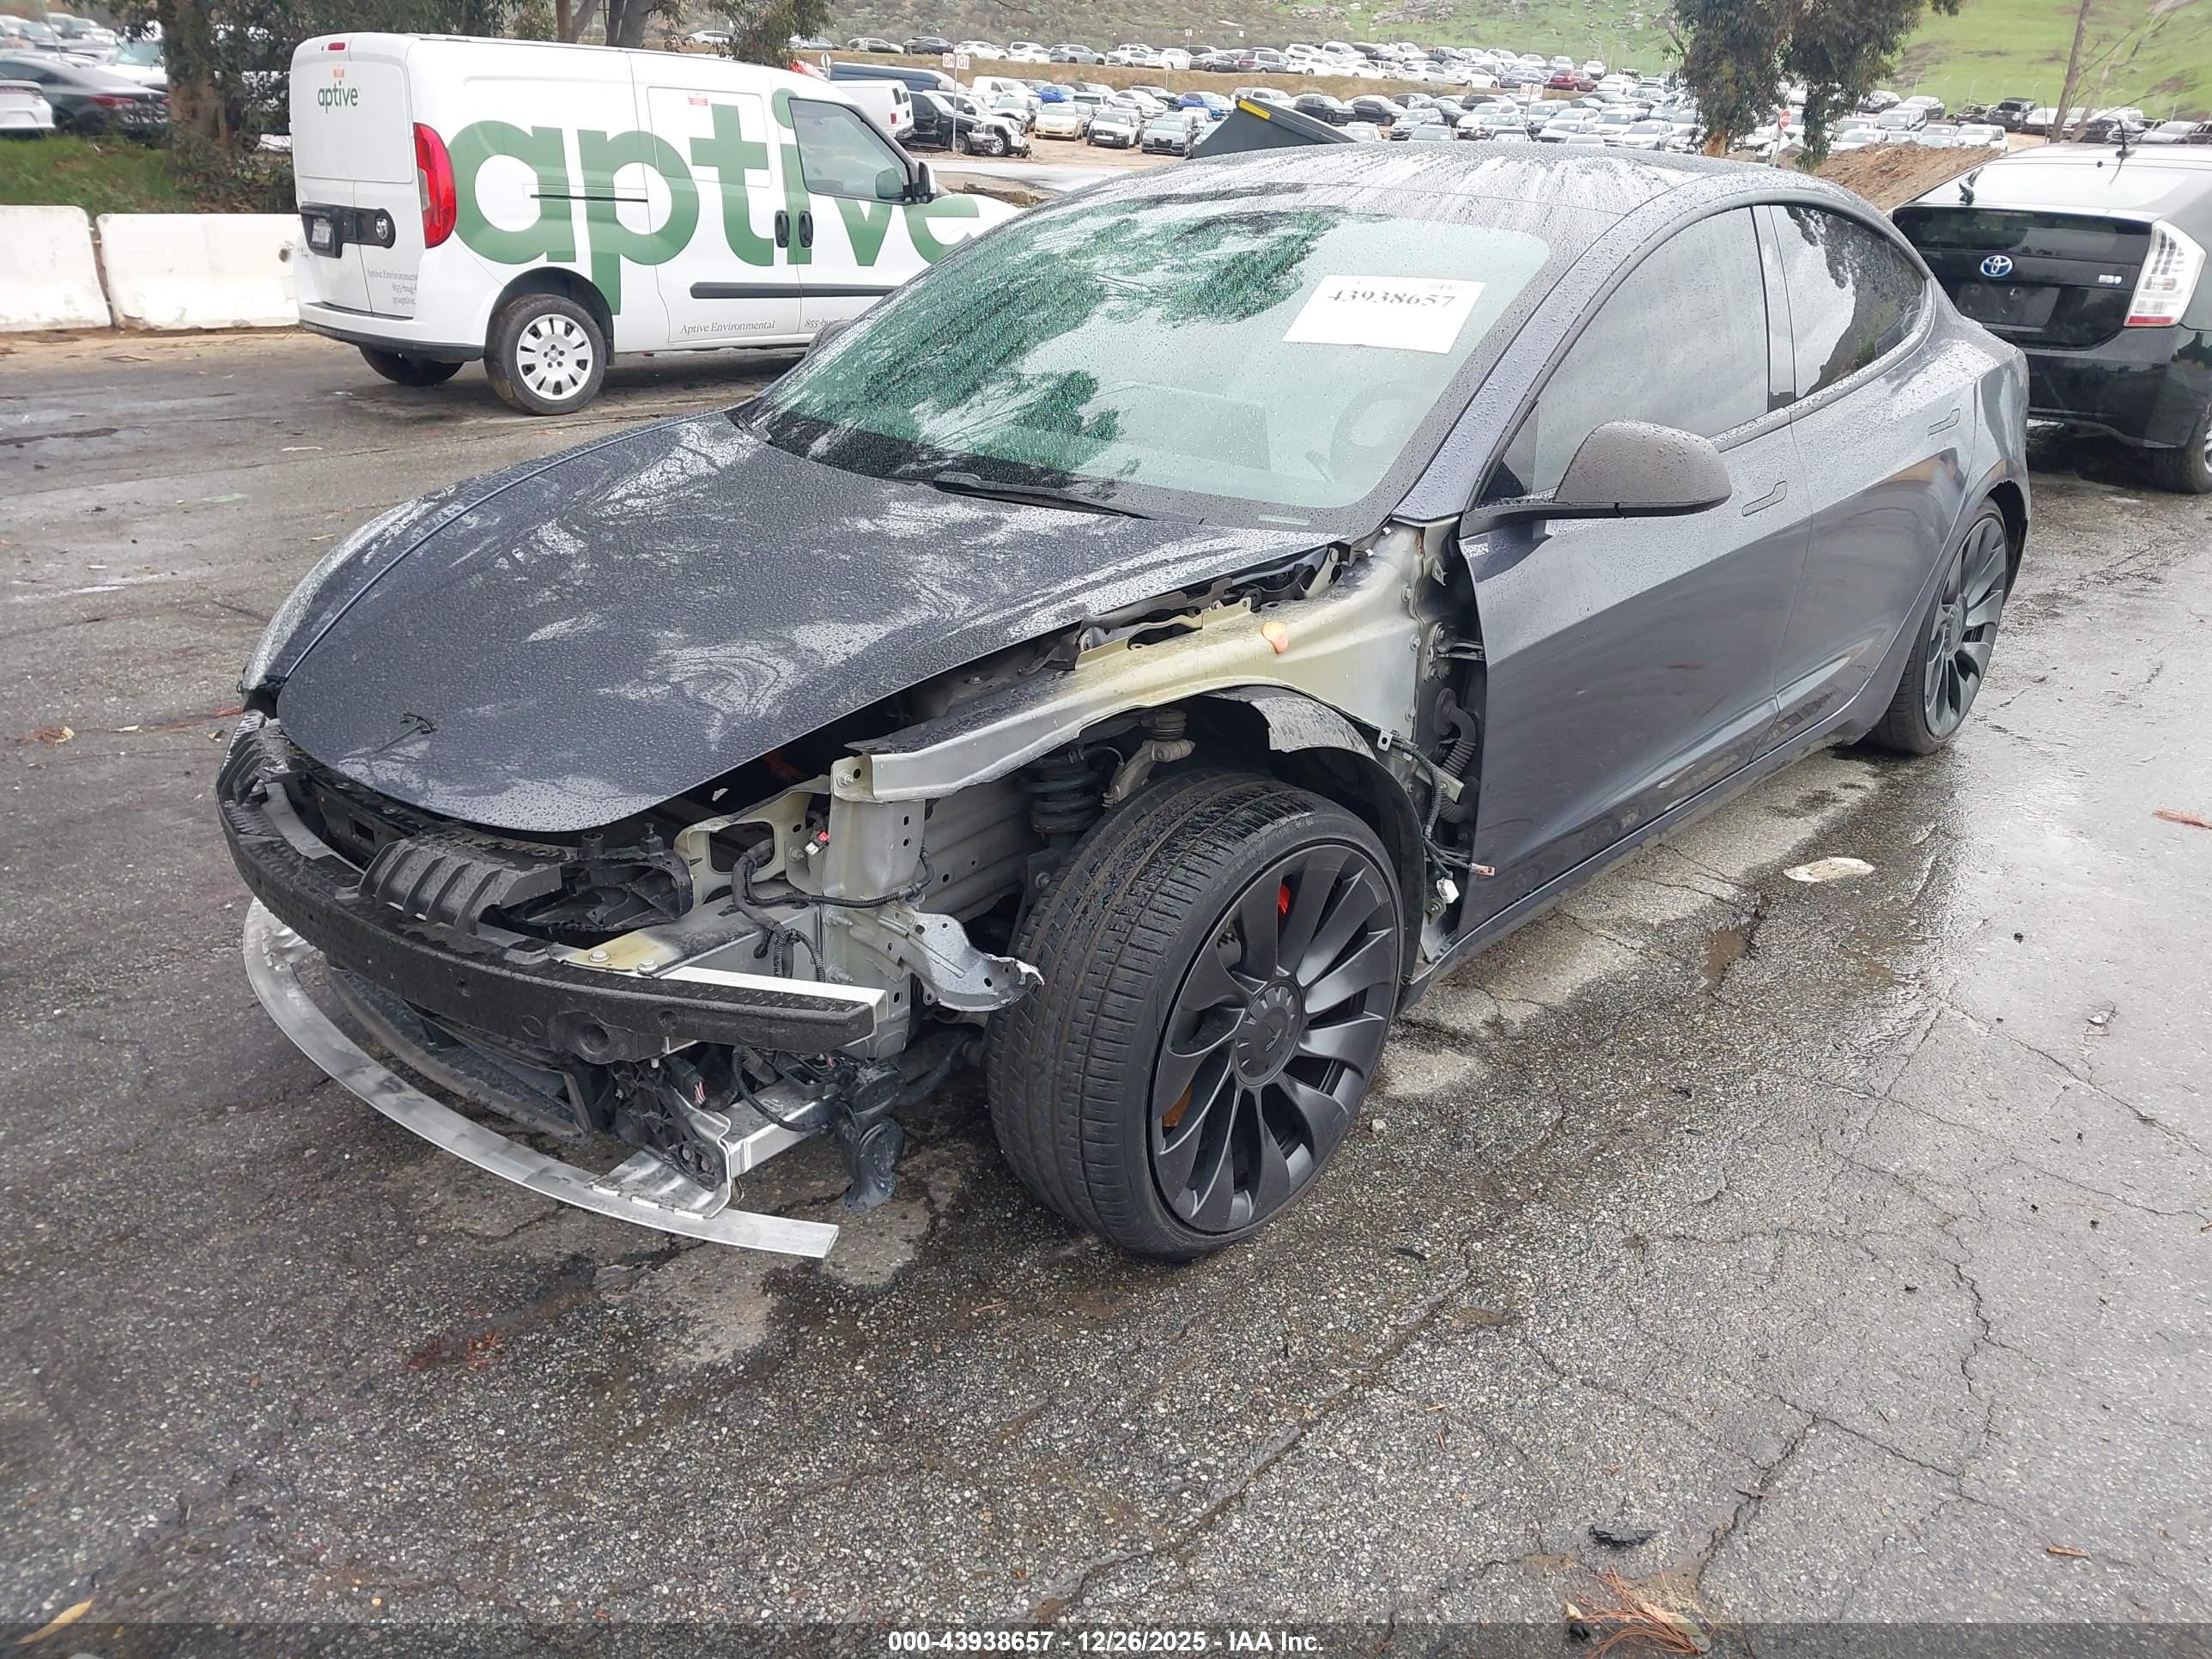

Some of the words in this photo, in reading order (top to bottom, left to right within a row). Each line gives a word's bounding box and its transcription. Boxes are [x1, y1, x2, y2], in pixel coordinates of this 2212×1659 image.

[944, 55, 954, 65] GH
[318, 80, 358, 113] aptive
[1328, 289, 1455, 307] 43938657
[680, 323, 709, 336] Aptive
[711, 319, 775, 331] Environmental
